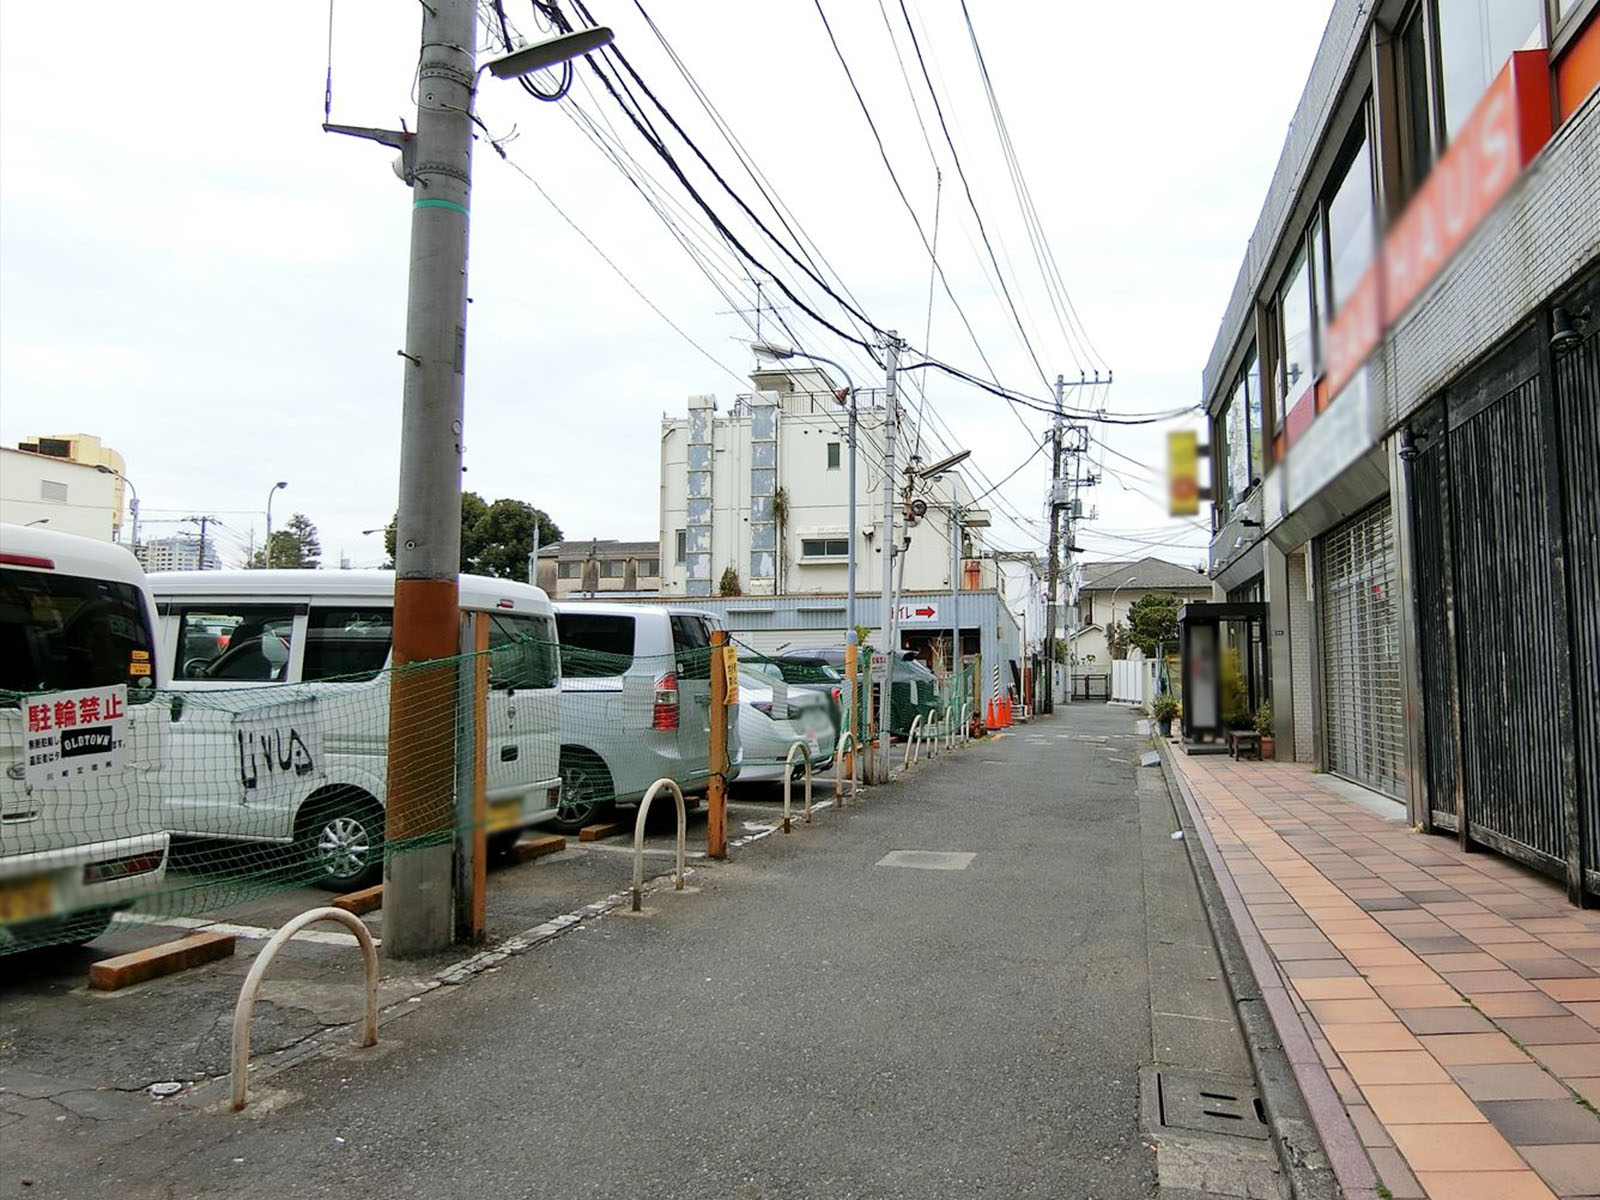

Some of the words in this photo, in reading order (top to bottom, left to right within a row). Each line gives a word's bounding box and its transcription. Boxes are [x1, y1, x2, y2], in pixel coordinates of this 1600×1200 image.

[28, 693, 124, 732] 駐輪禁止
[64, 734, 110, 751] OLDTOWN
